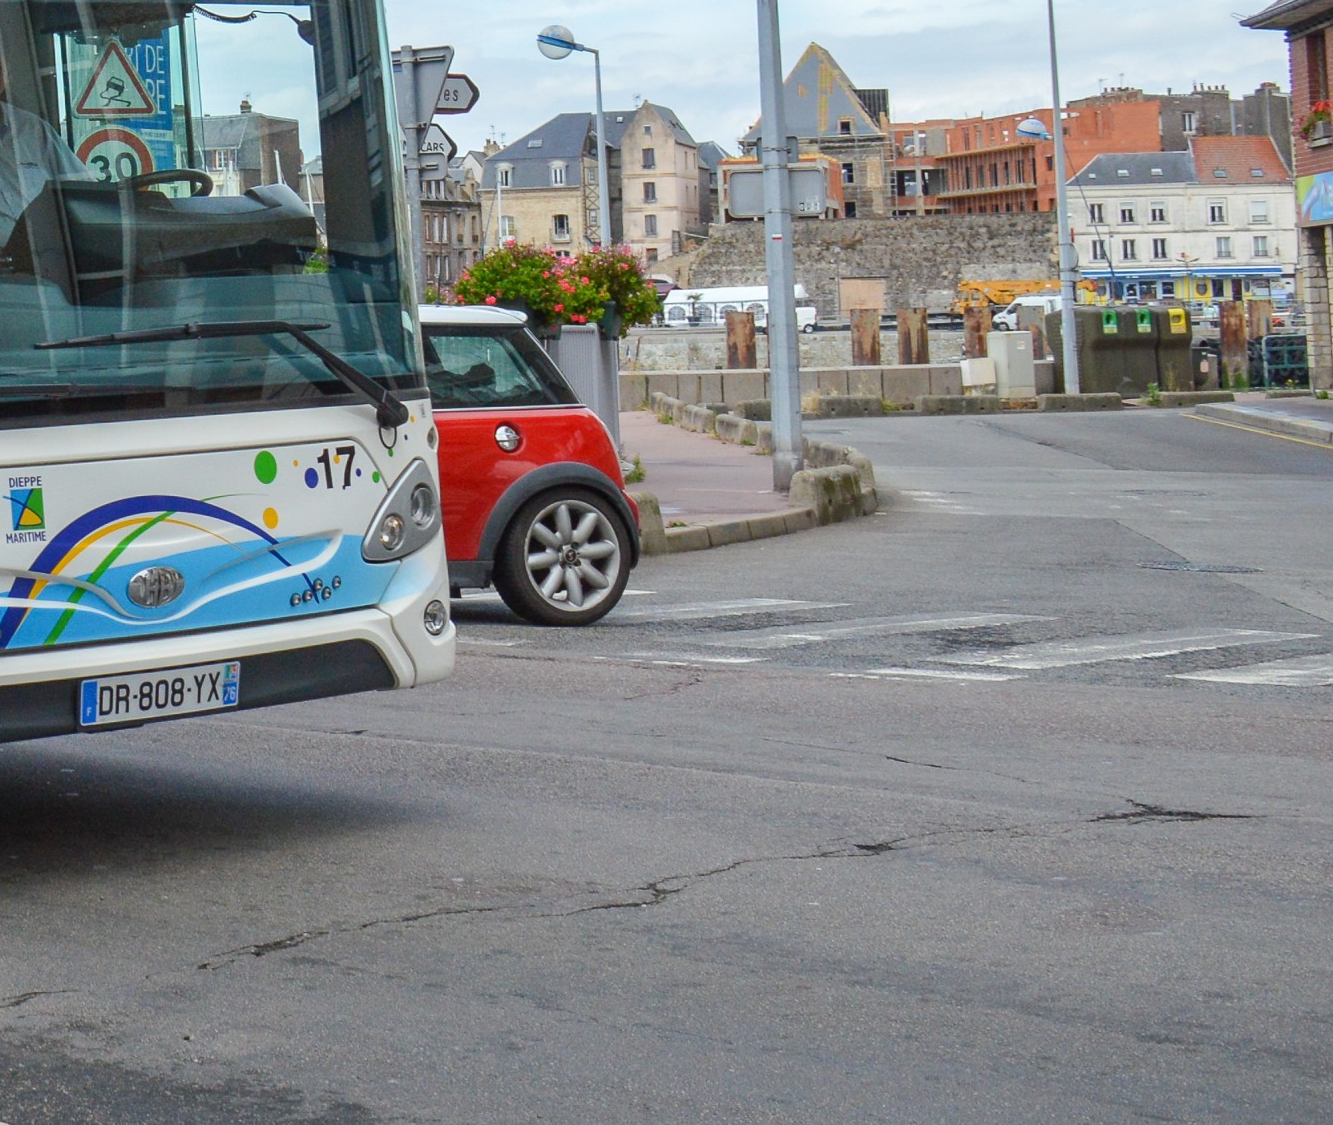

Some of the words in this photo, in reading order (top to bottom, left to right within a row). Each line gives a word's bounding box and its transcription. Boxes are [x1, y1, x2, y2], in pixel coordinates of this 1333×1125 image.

[145, 44, 164, 74] DE
[90, 152, 137, 182] 30
[8, 476, 42, 488] DIEPPE
[317, 445, 355, 489] 17
[5, 530, 47, 544] MARITIME
[98, 672, 221, 716] DR-808-YX
